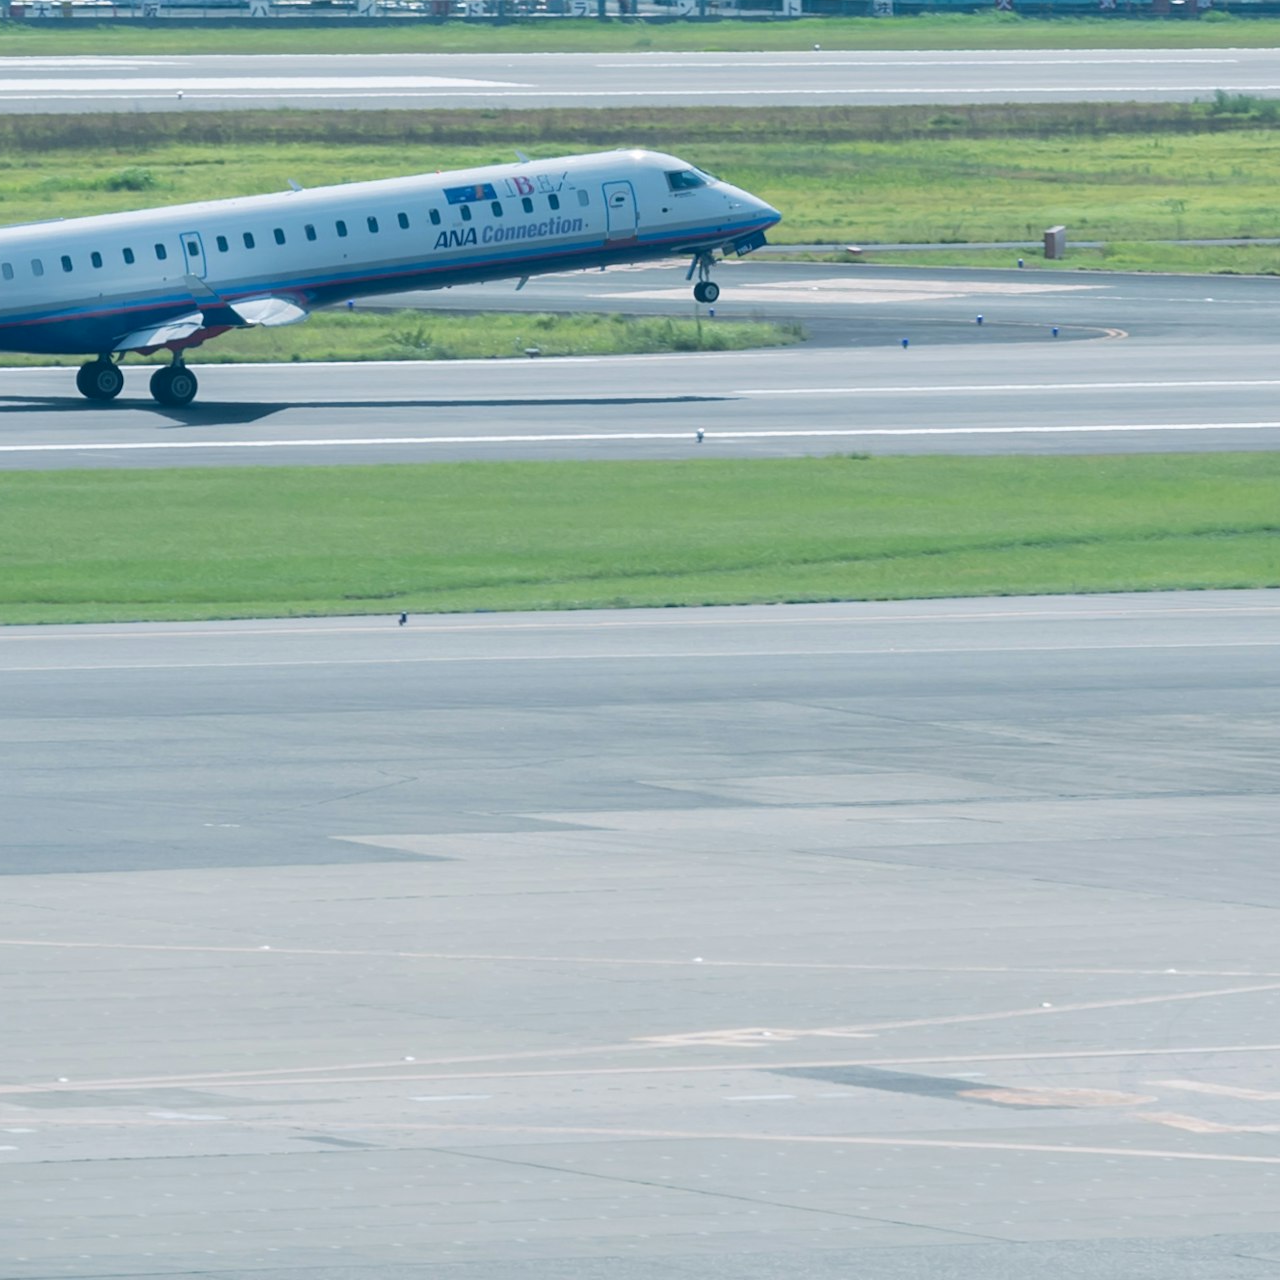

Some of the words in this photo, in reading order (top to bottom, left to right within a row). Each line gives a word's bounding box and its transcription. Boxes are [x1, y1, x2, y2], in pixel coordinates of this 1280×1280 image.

[501, 171, 576, 198] IBEX
[433, 227, 478, 250] ANA
[482, 216, 583, 244] Connection
